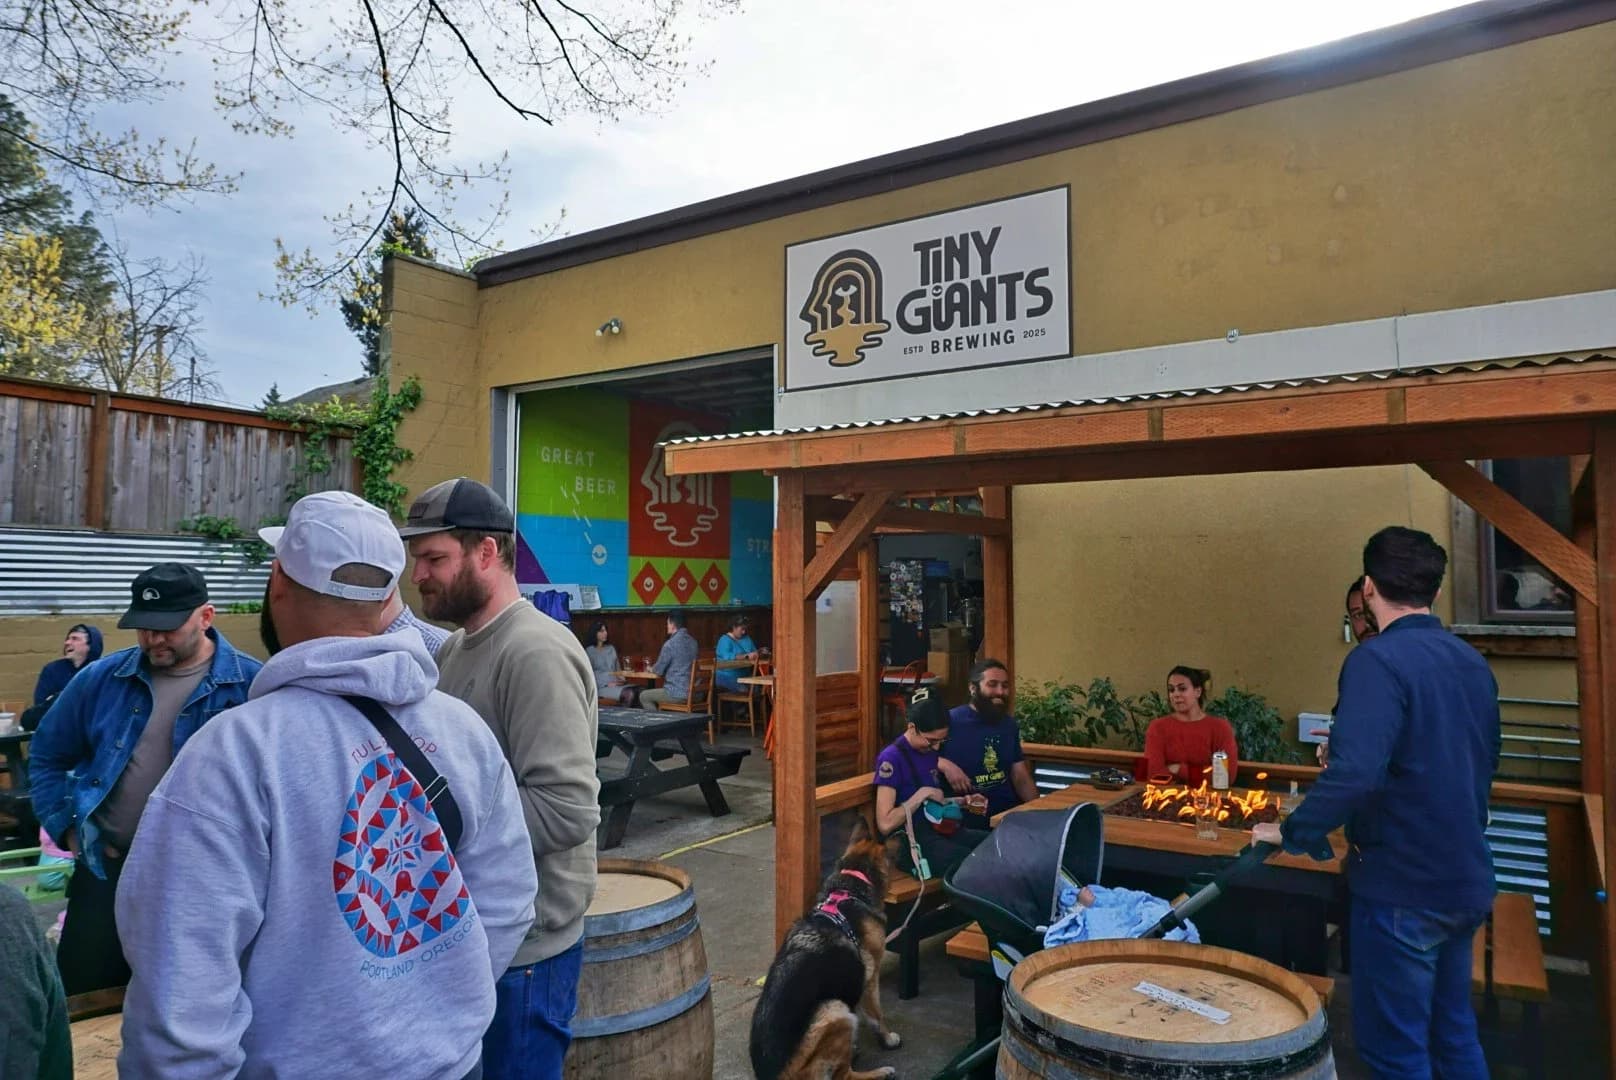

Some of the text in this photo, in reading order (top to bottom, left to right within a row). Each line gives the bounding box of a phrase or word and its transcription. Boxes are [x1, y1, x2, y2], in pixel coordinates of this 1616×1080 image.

[931, 330, 1015, 354] BREWING
[1022, 328, 1046, 339] 2025
[541, 447, 595, 467] GREAT
[575, 476, 617, 495] BEER
[360, 959, 415, 980] PORTLAND
